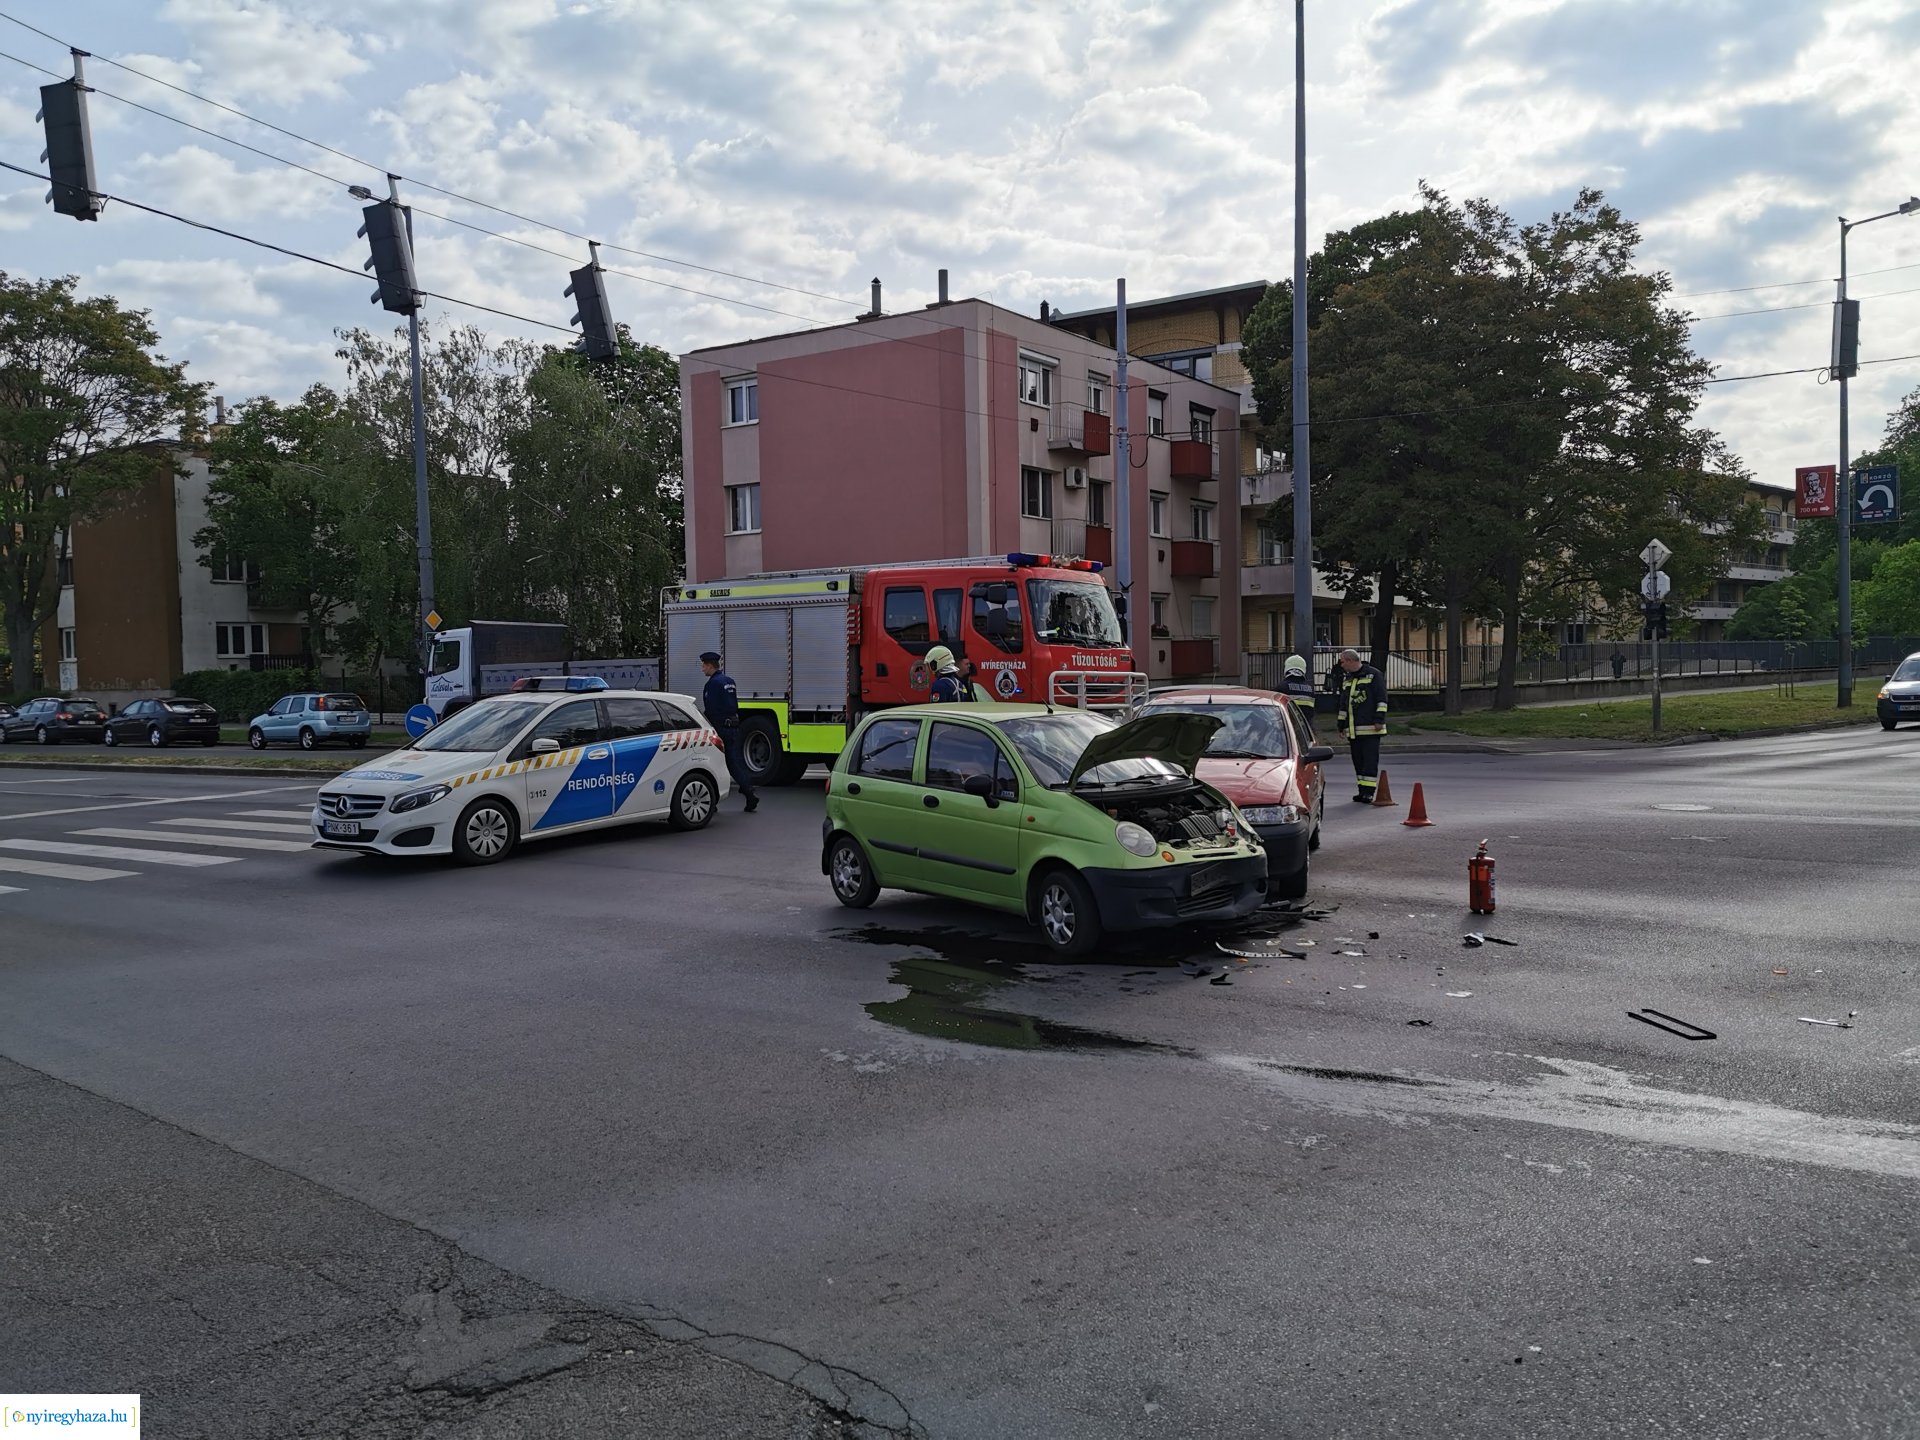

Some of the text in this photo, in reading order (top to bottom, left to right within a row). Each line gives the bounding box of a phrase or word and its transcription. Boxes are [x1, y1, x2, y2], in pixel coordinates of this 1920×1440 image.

[981, 659, 1027, 670] NYÍREGYHÁZA
[1071, 651, 1118, 668] TŰZOLTÓSÁG
[568, 772, 635, 791] RENDŐRSÉG
[535, 789, 547, 798] 112
